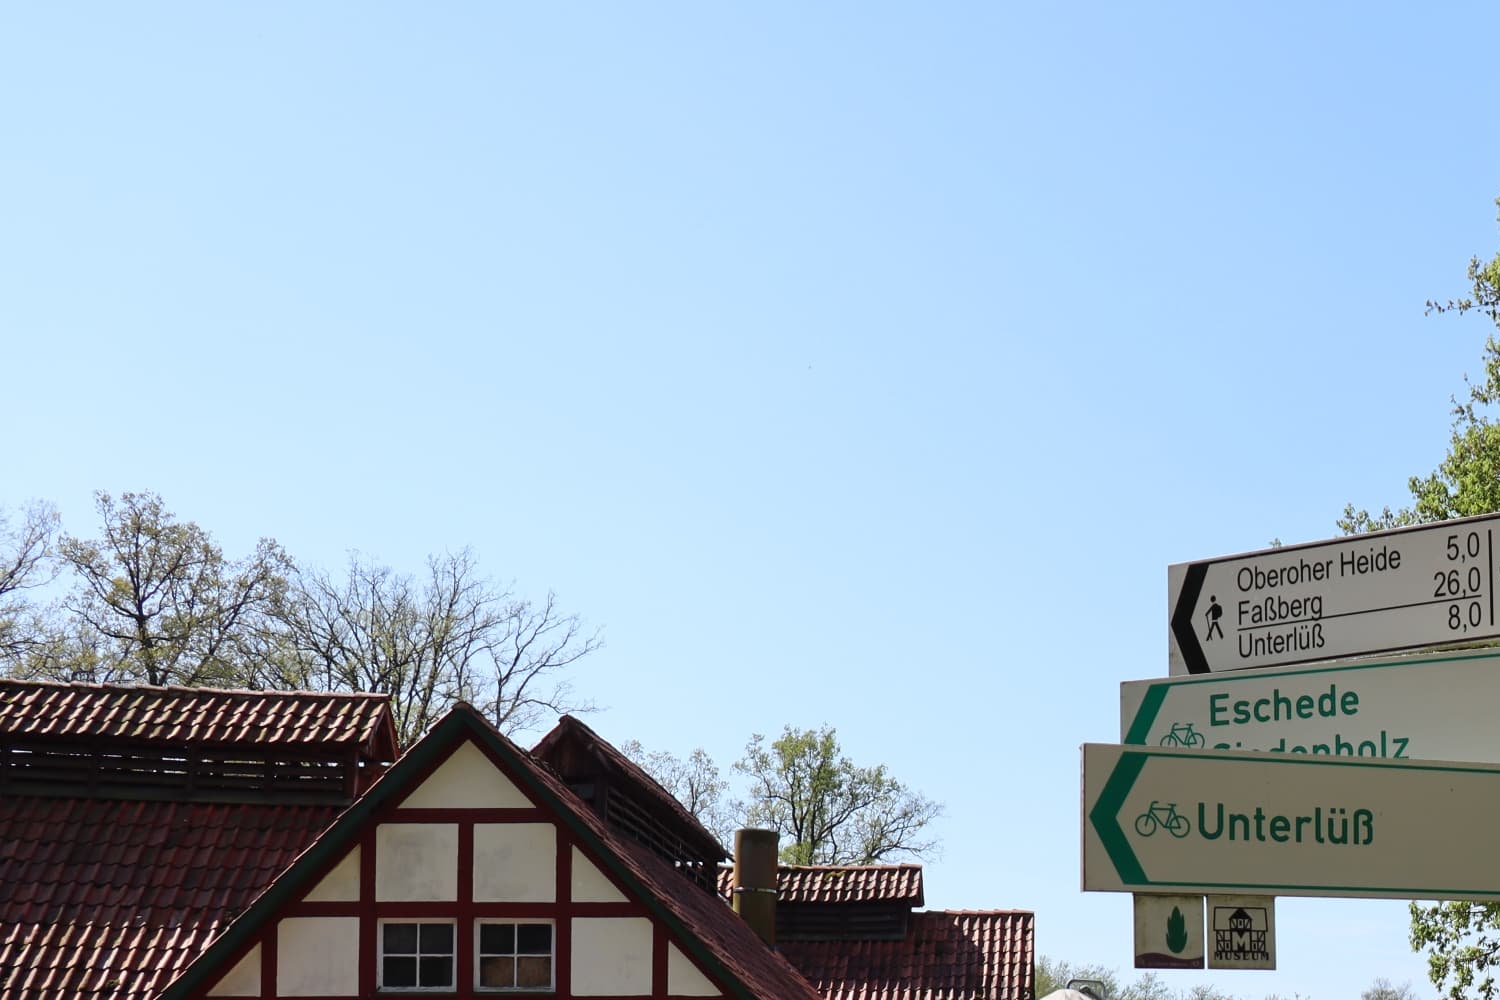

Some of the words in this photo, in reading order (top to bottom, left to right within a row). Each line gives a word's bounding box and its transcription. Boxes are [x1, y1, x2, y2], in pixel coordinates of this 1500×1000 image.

[1237, 558, 1334, 593] Oberoher
[1340, 546, 1401, 577] Heide
[1447, 532, 1480, 562] 5,0
[1238, 594, 1323, 626] Faßberg
[1433, 566, 1481, 598] 26,0
[1238, 621, 1325, 658] Unterlüß
[1448, 601, 1481, 631] 8,0
[1210, 684, 1359, 726] Eschede
[1197, 801, 1374, 845] Unterlüß
[1214, 951, 1269, 961] MUSEUM
